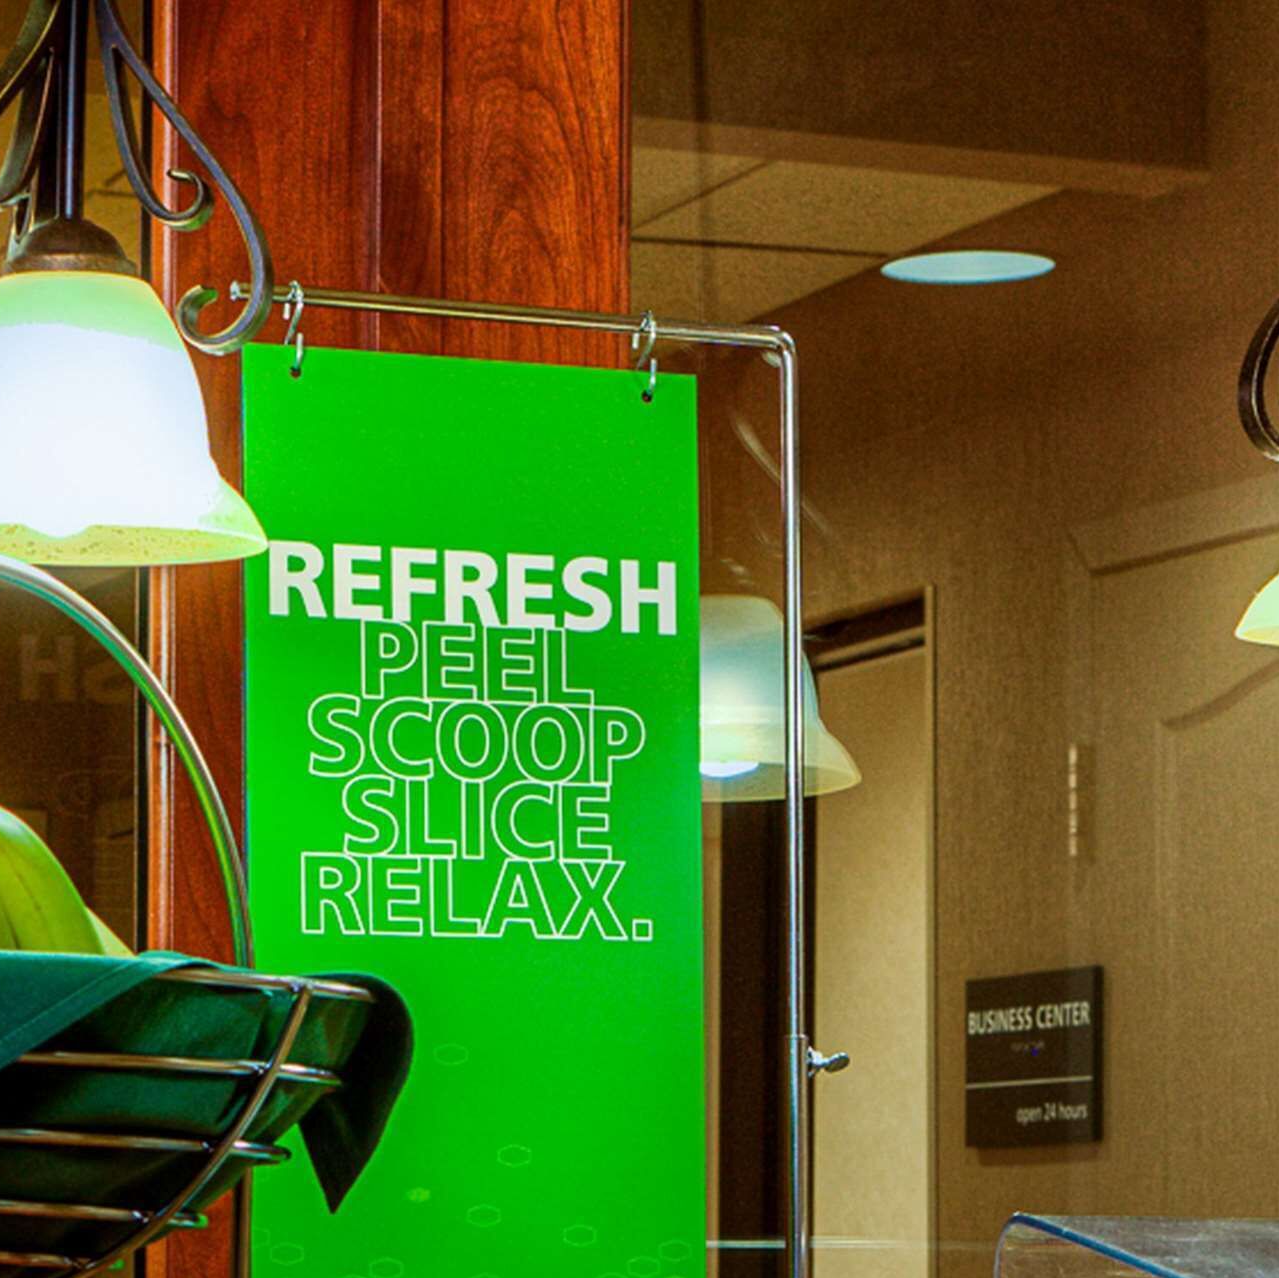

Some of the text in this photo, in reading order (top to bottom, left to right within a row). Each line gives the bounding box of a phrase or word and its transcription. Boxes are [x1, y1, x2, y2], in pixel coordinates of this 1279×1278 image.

[268, 540, 677, 635] REFRESH
[361, 618, 593, 705] PEEL
[308, 693, 646, 785] SCOOP
[342, 775, 613, 861] SLICE
[301, 852, 653, 941] RELAX.
[967, 1001, 1091, 1034] BUSINESS CENTER
[1016, 1102, 1088, 1127] open 24 hours
